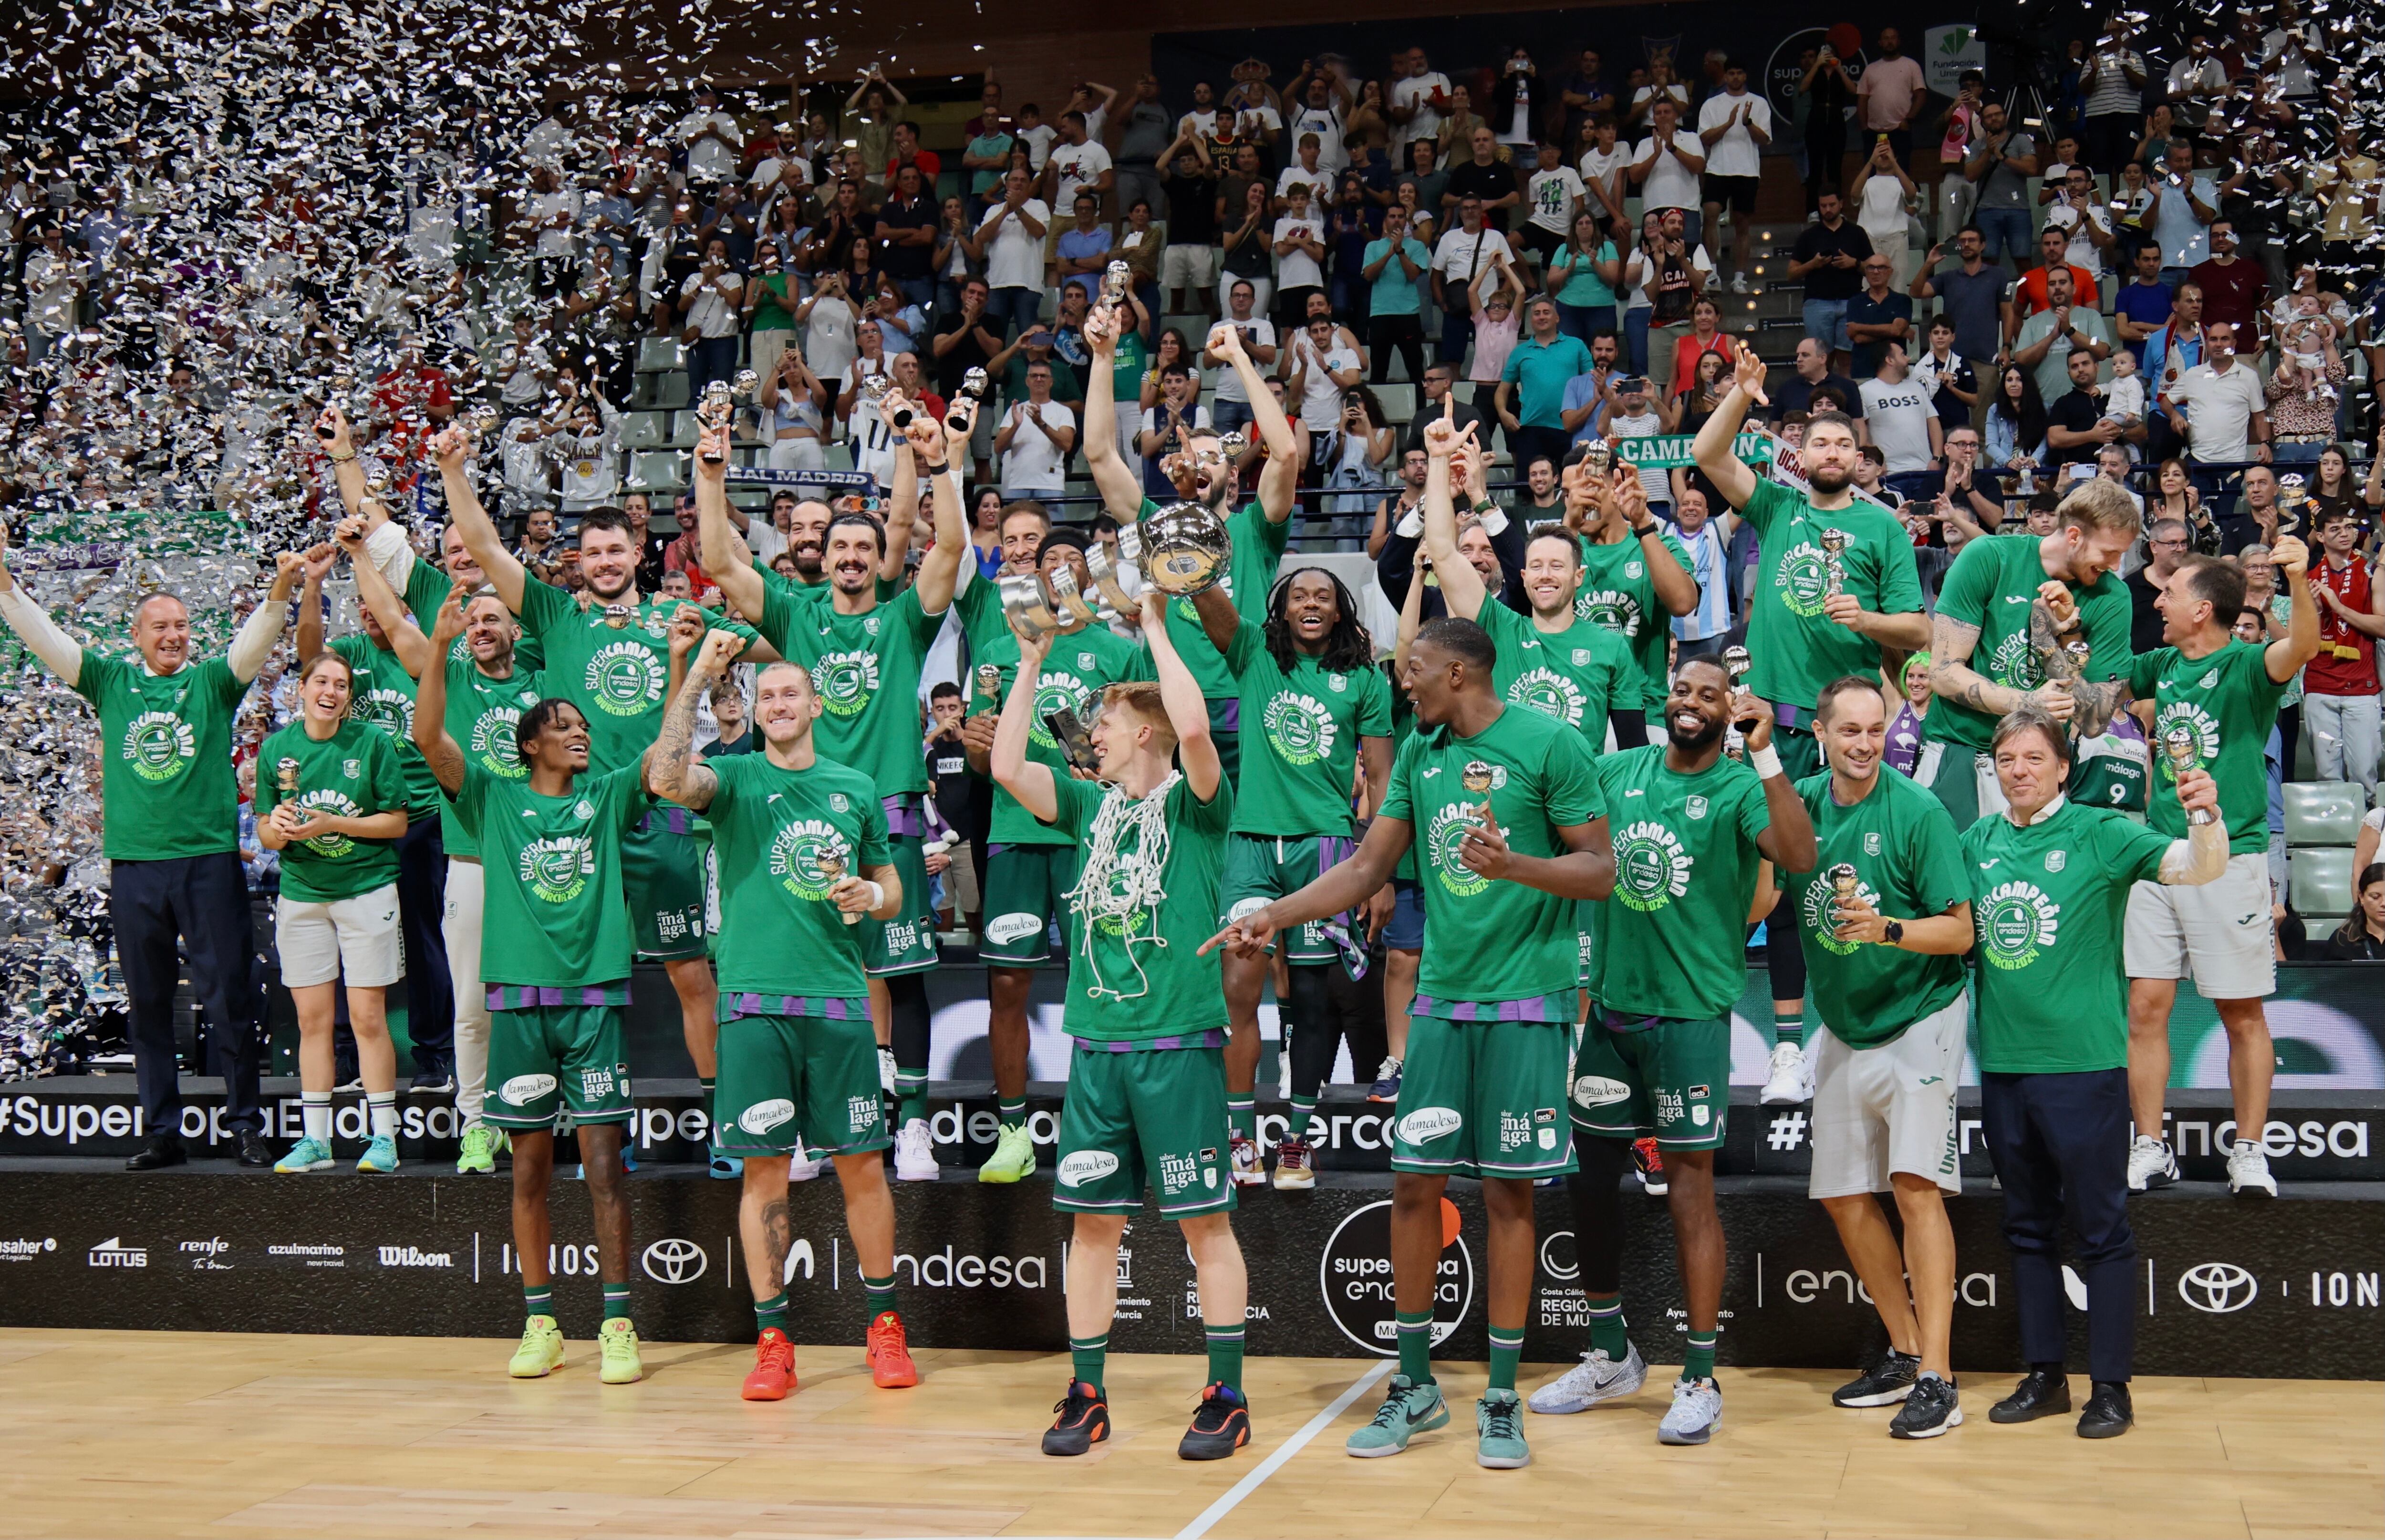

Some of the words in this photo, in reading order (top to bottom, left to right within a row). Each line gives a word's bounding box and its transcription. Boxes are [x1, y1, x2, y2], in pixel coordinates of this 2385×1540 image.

[1774, 63, 1860, 80] suppa
[1933, 59, 1978, 68] Fundación
[1878, 395, 1920, 410] BOSS
[1622, 435, 1759, 461] CAMPN
[777, 470, 868, 485] MADRID
[593, 694, 626, 716] MURCIA
[625, 700, 648, 716] 2024
[495, 738, 518, 746] supercop
[937, 761, 953, 770] NIKE
[2110, 783, 2126, 803] 9
[1630, 861, 1660, 872] supercopa
[1632, 868, 1659, 879] endesa
[532, 883, 567, 903] MURCIA
[566, 878, 586, 900] 2024
[783, 878, 819, 901] MURCIA
[990, 916, 1039, 937] famadesa
[1985, 946, 2015, 970] MURCIA
[2015, 947, 2040, 969] 2024
[505, 1077, 554, 1098] famadesa
[1575, 1078, 1627, 1096] famadesa
[745, 1102, 793, 1127] famadesa
[1402, 1111, 1458, 1136] famadesa
[1060, 1154, 1116, 1177] famadesa
[180, 1236, 229, 1256] renfe
[268, 1243, 344, 1255] azulmarino
[89, 1252, 147, 1267] LOTUS
[192, 1258, 207, 1269] Tu
[207, 1260, 235, 1269] tren
[379, 1246, 453, 1267] Wilson
[503, 1242, 599, 1275] INOS
[859, 1245, 1046, 1288] ndesa
[2312, 1271, 2378, 1307] ION
[1541, 1296, 1588, 1313] REGIÓ
[1541, 1314, 1562, 1326] DE
